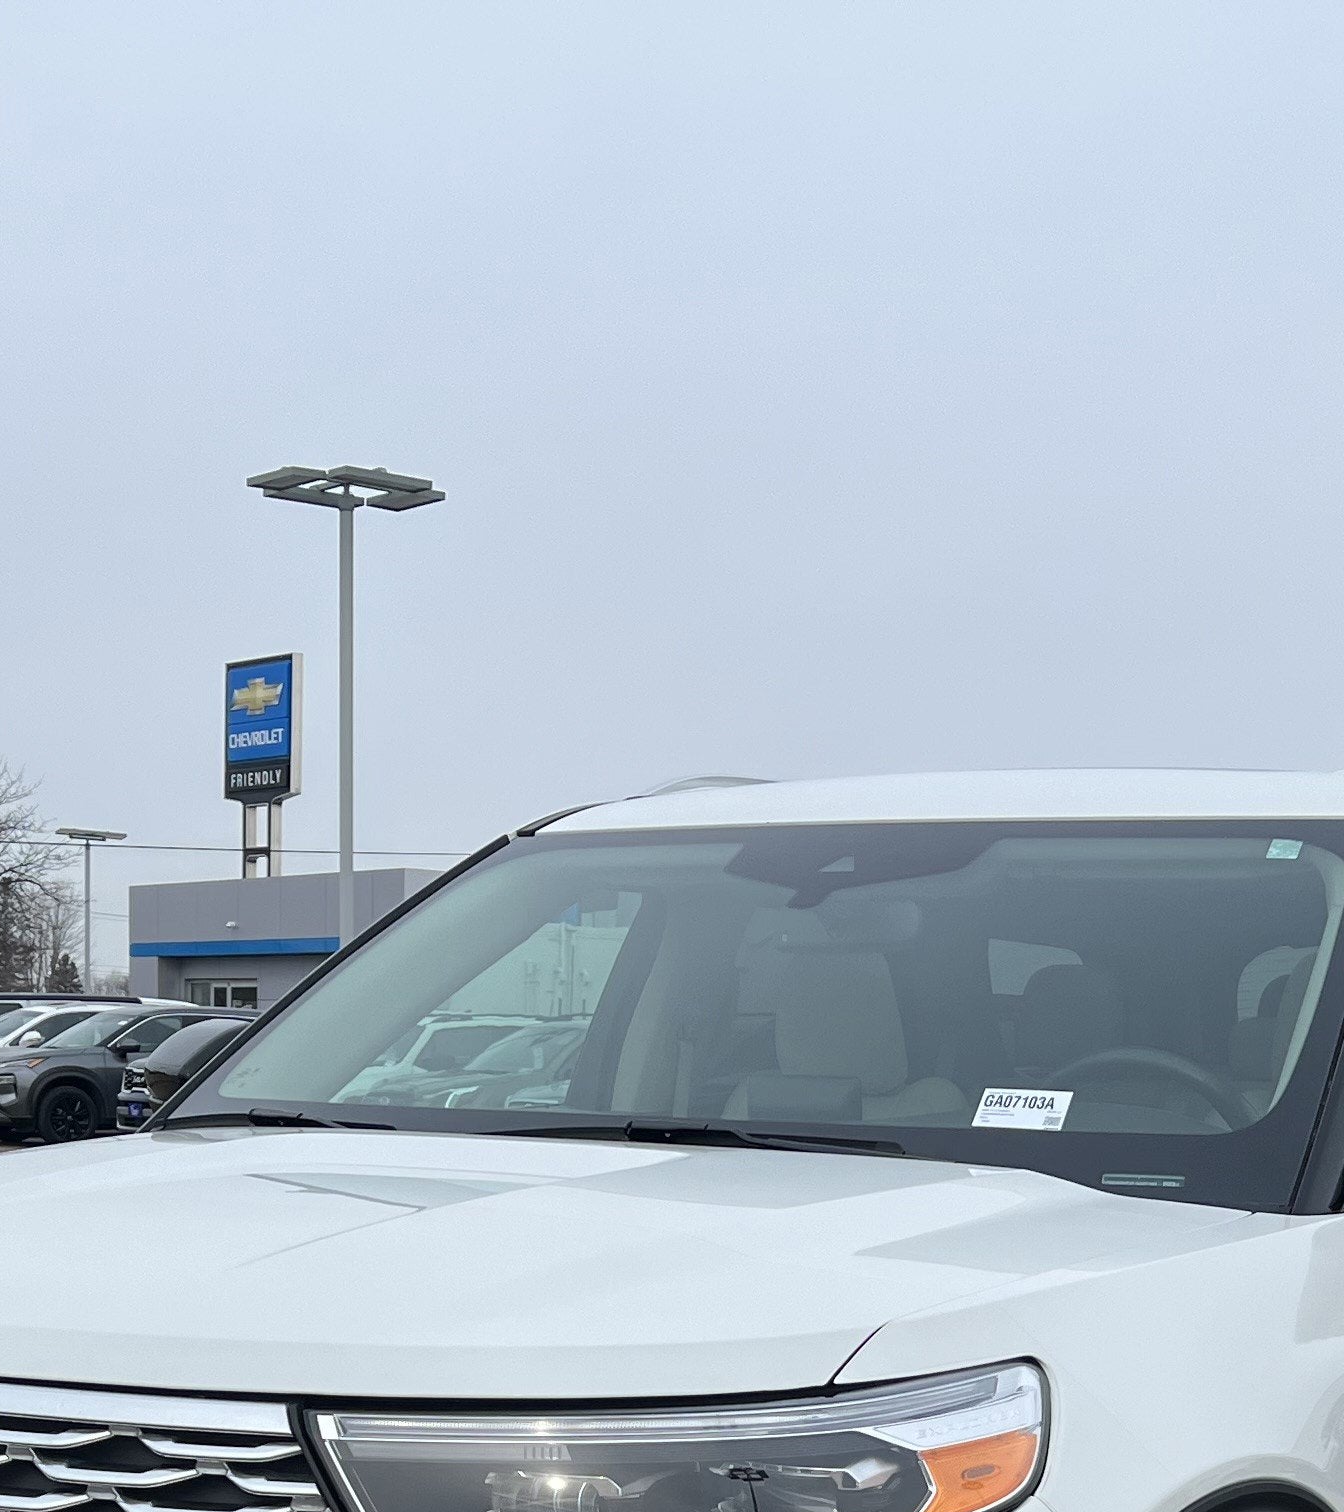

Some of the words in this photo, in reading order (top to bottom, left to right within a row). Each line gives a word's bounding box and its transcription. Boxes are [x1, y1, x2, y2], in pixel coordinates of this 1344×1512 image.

[228, 728, 284, 749] CHEVROLET
[230, 769, 282, 788] FRIENDLY
[984, 1094, 1055, 1110] GA07103A
